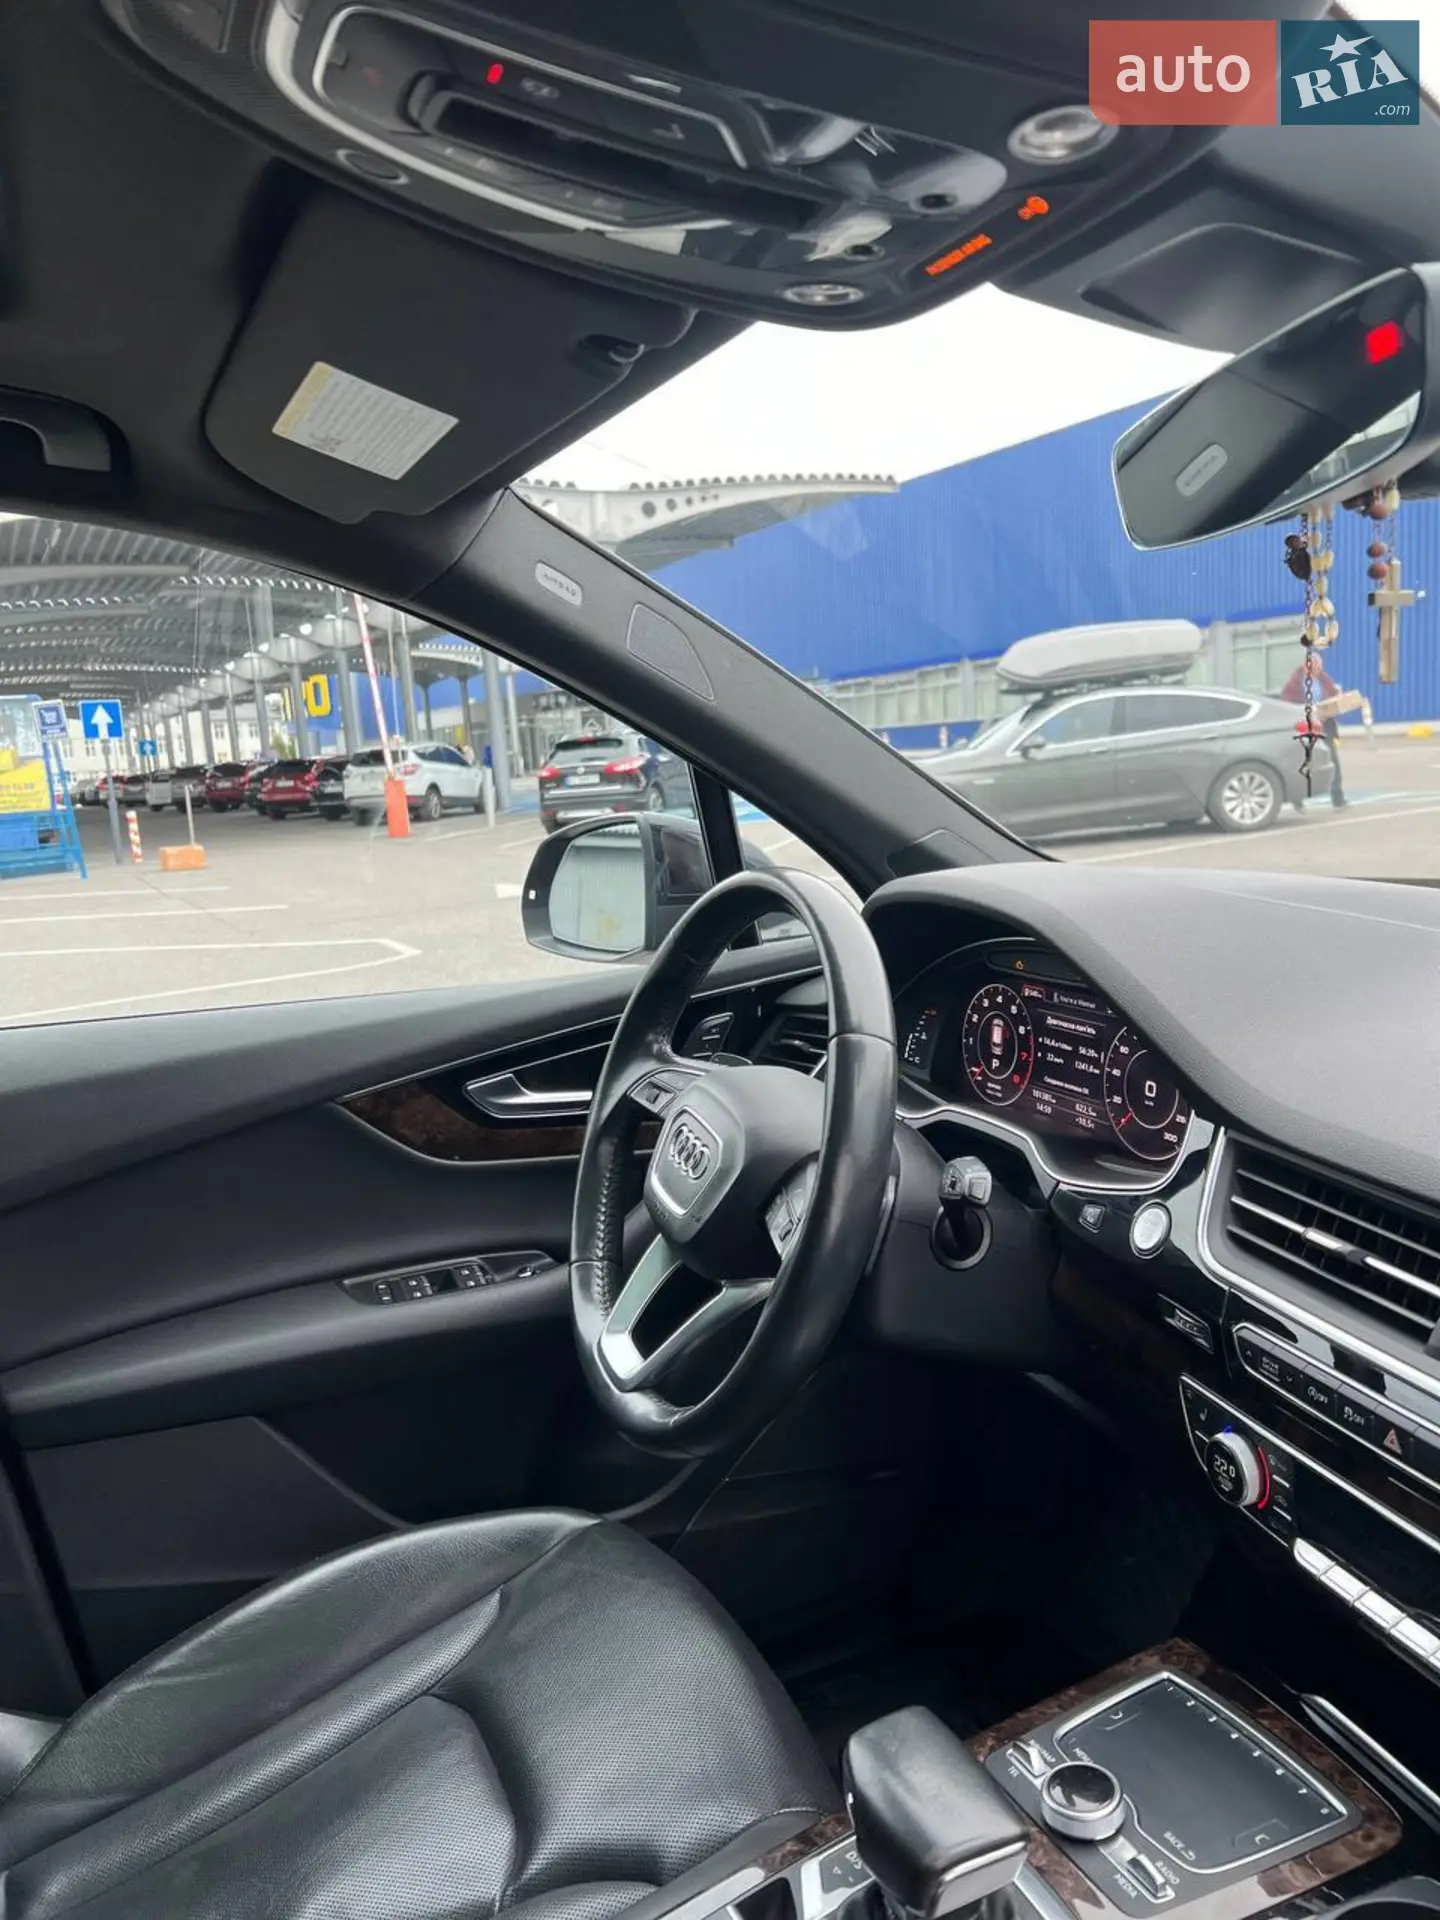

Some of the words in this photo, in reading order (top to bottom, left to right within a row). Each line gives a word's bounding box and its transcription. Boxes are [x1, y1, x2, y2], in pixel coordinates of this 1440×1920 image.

[992, 1059, 1000, 1070] P
[1154, 1861, 1181, 1885] RADIO
[1113, 1873, 1139, 1899] MEDIA
